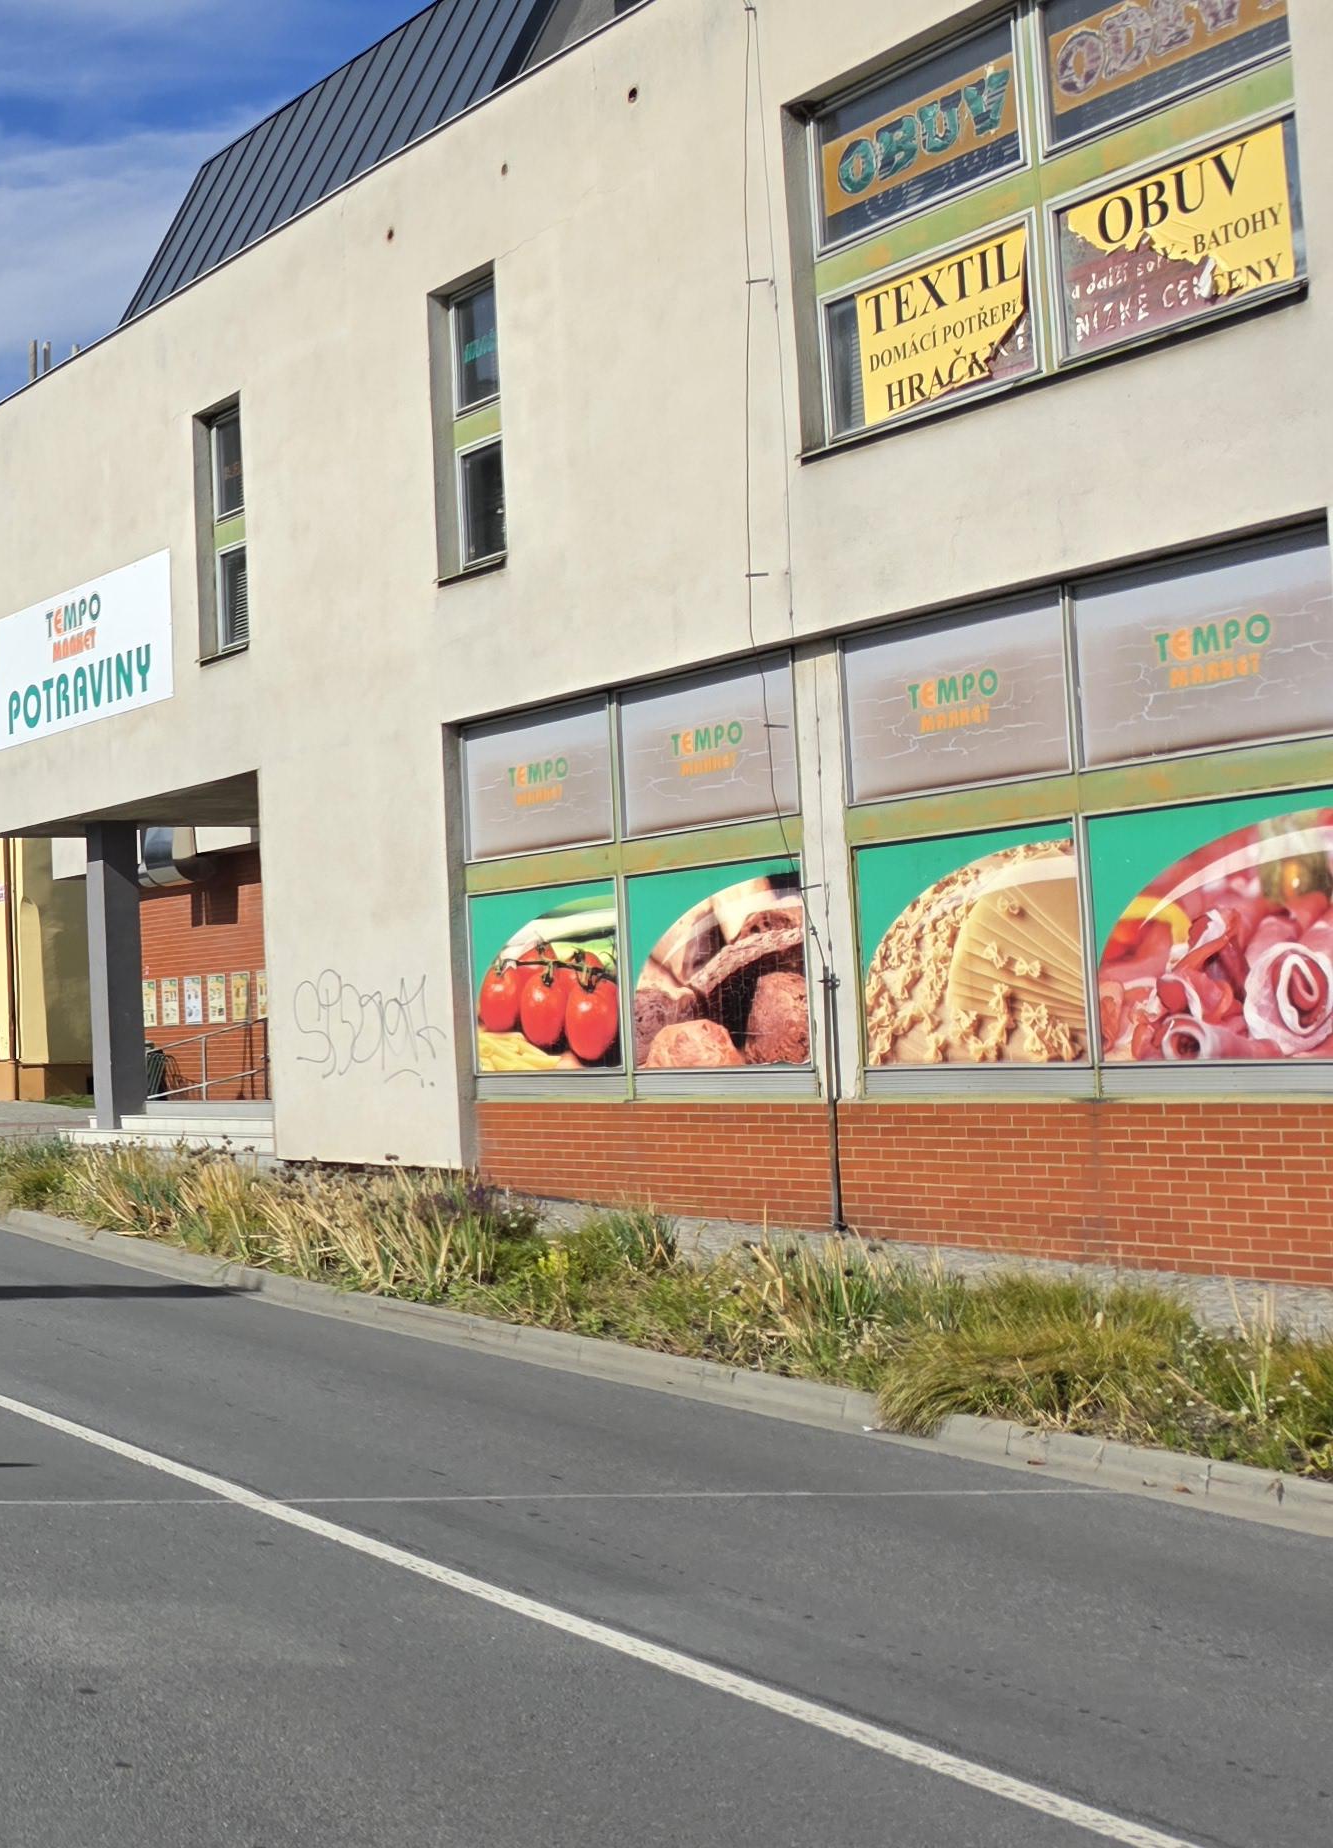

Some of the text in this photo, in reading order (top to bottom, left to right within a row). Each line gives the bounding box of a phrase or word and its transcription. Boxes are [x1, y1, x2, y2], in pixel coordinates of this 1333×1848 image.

[838, 69, 1010, 194] OBUV
[1098, 141, 1248, 244] OBUV
[1193, 203, 1283, 255] BATOHY
[866, 240, 1021, 336] TEXTIL
[870, 325, 937, 373] DOMÁCÍ
[45, 593, 101, 638] TEMPO
[1154, 613, 1272, 662] TEMPO
[8, 643, 151, 735] POTRAVINY
[907, 668, 999, 710] TEMPO
[1169, 653, 1261, 689] MARKET
[671, 721, 743, 757] TEMPO
[508, 757, 569, 787] TEMPO
